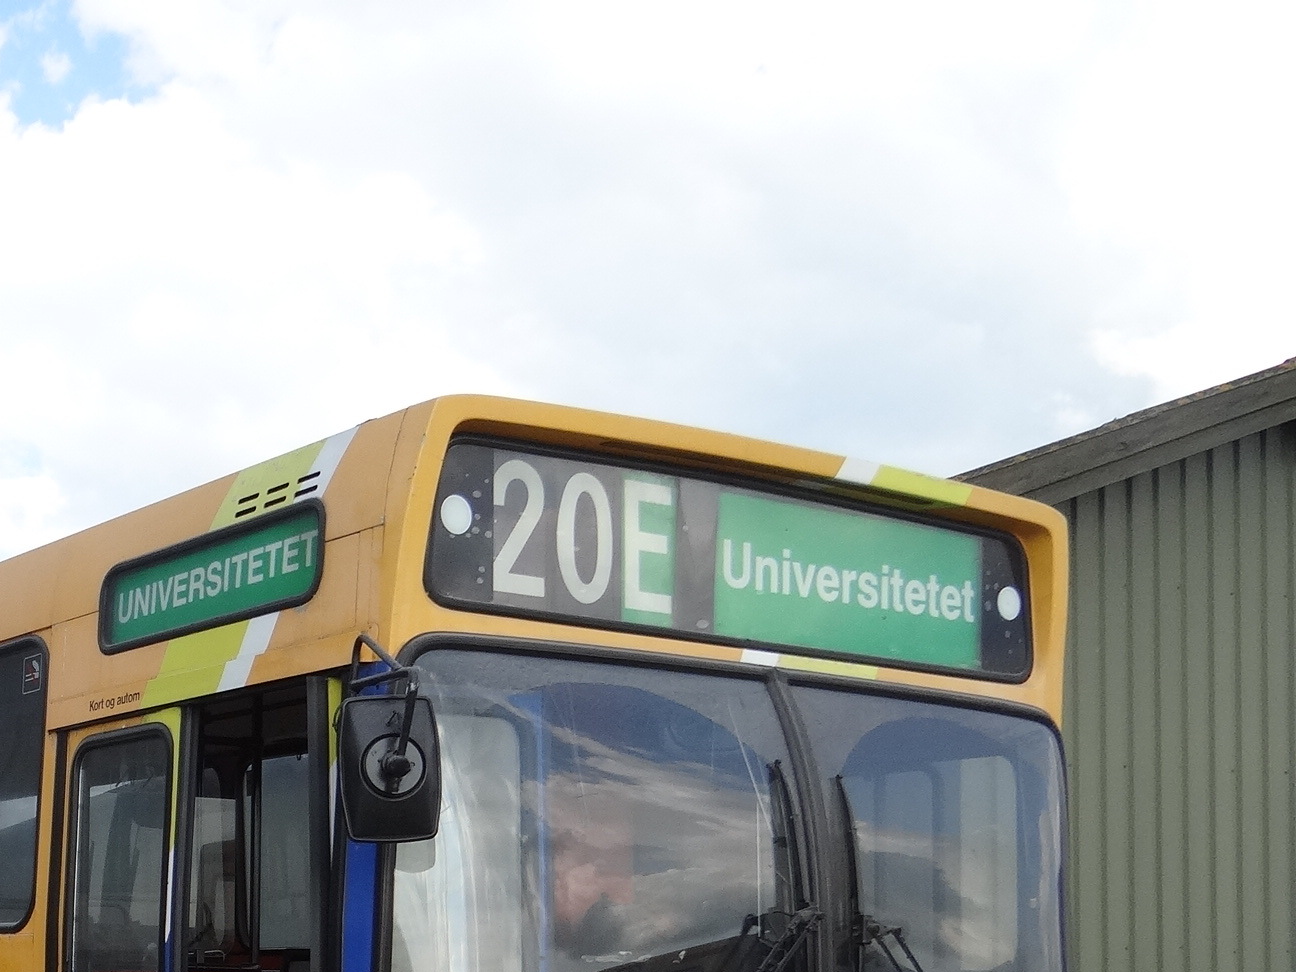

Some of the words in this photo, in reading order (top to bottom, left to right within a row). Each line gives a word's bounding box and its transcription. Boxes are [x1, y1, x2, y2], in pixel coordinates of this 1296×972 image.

[118, 529, 319, 624] UNIVERSITETET
[493, 459, 672, 614] 20E
[722, 538, 975, 623] Universitetet
[89, 698, 104, 712] Kort
[105, 698, 115, 710] og
[116, 692, 140, 706] autom
